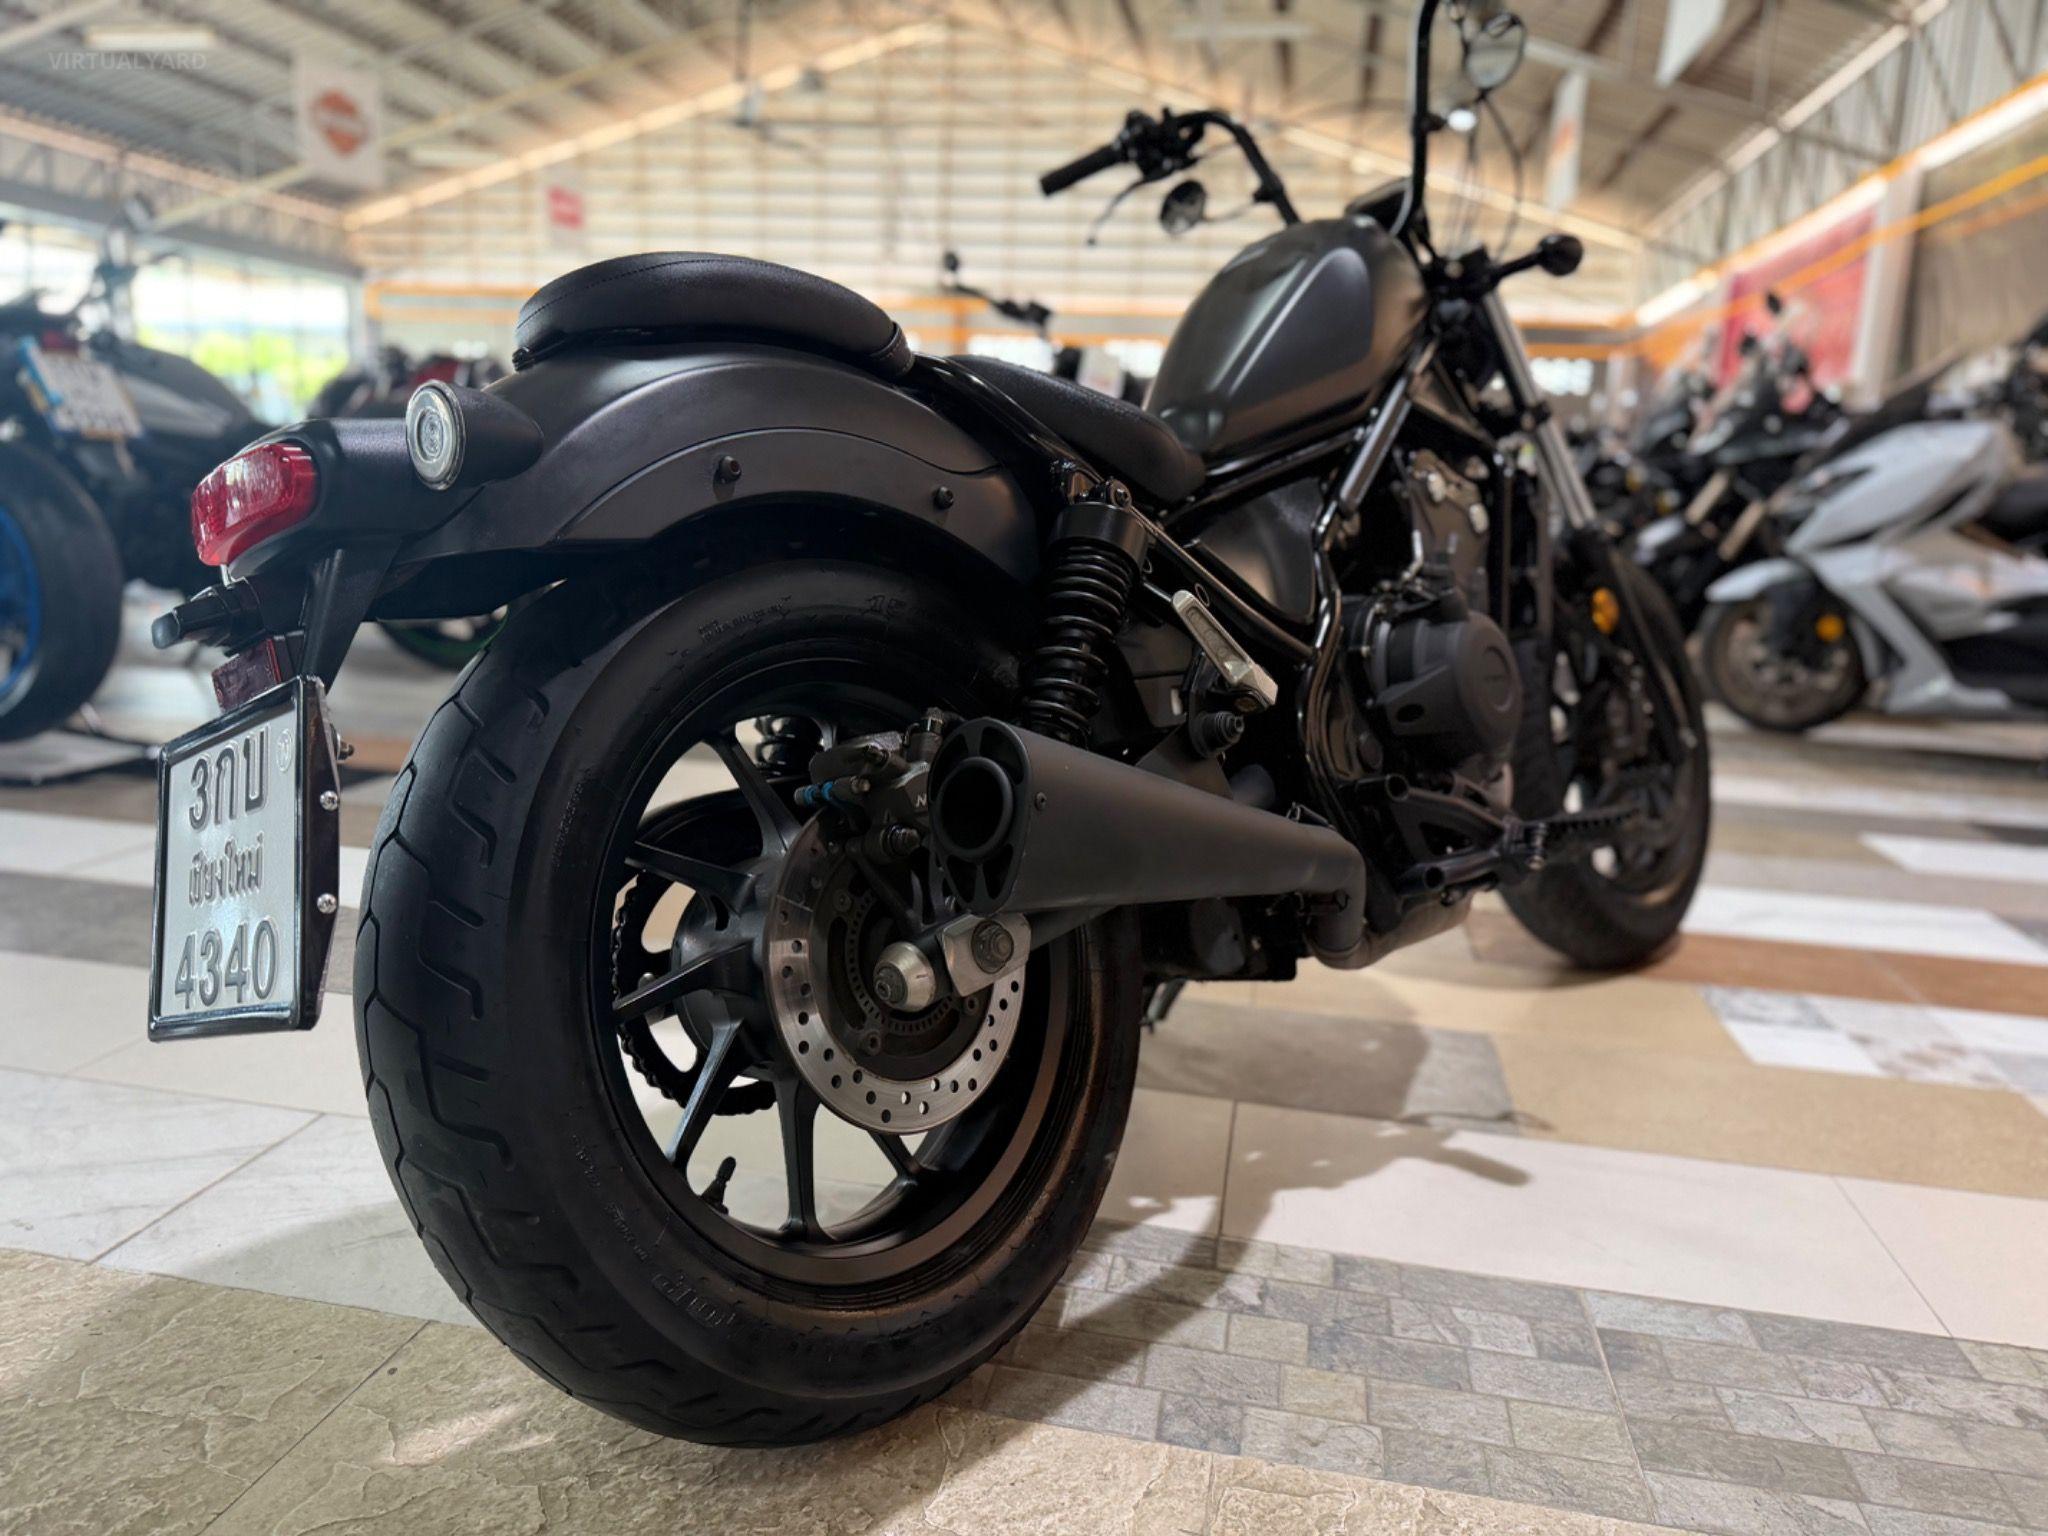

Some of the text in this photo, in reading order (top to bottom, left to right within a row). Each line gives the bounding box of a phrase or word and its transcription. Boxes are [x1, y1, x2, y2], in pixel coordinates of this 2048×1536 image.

[188, 726, 269, 831] 3กบ
[188, 832, 264, 907] เชียงใหม่
[174, 918, 278, 1009] 4340
